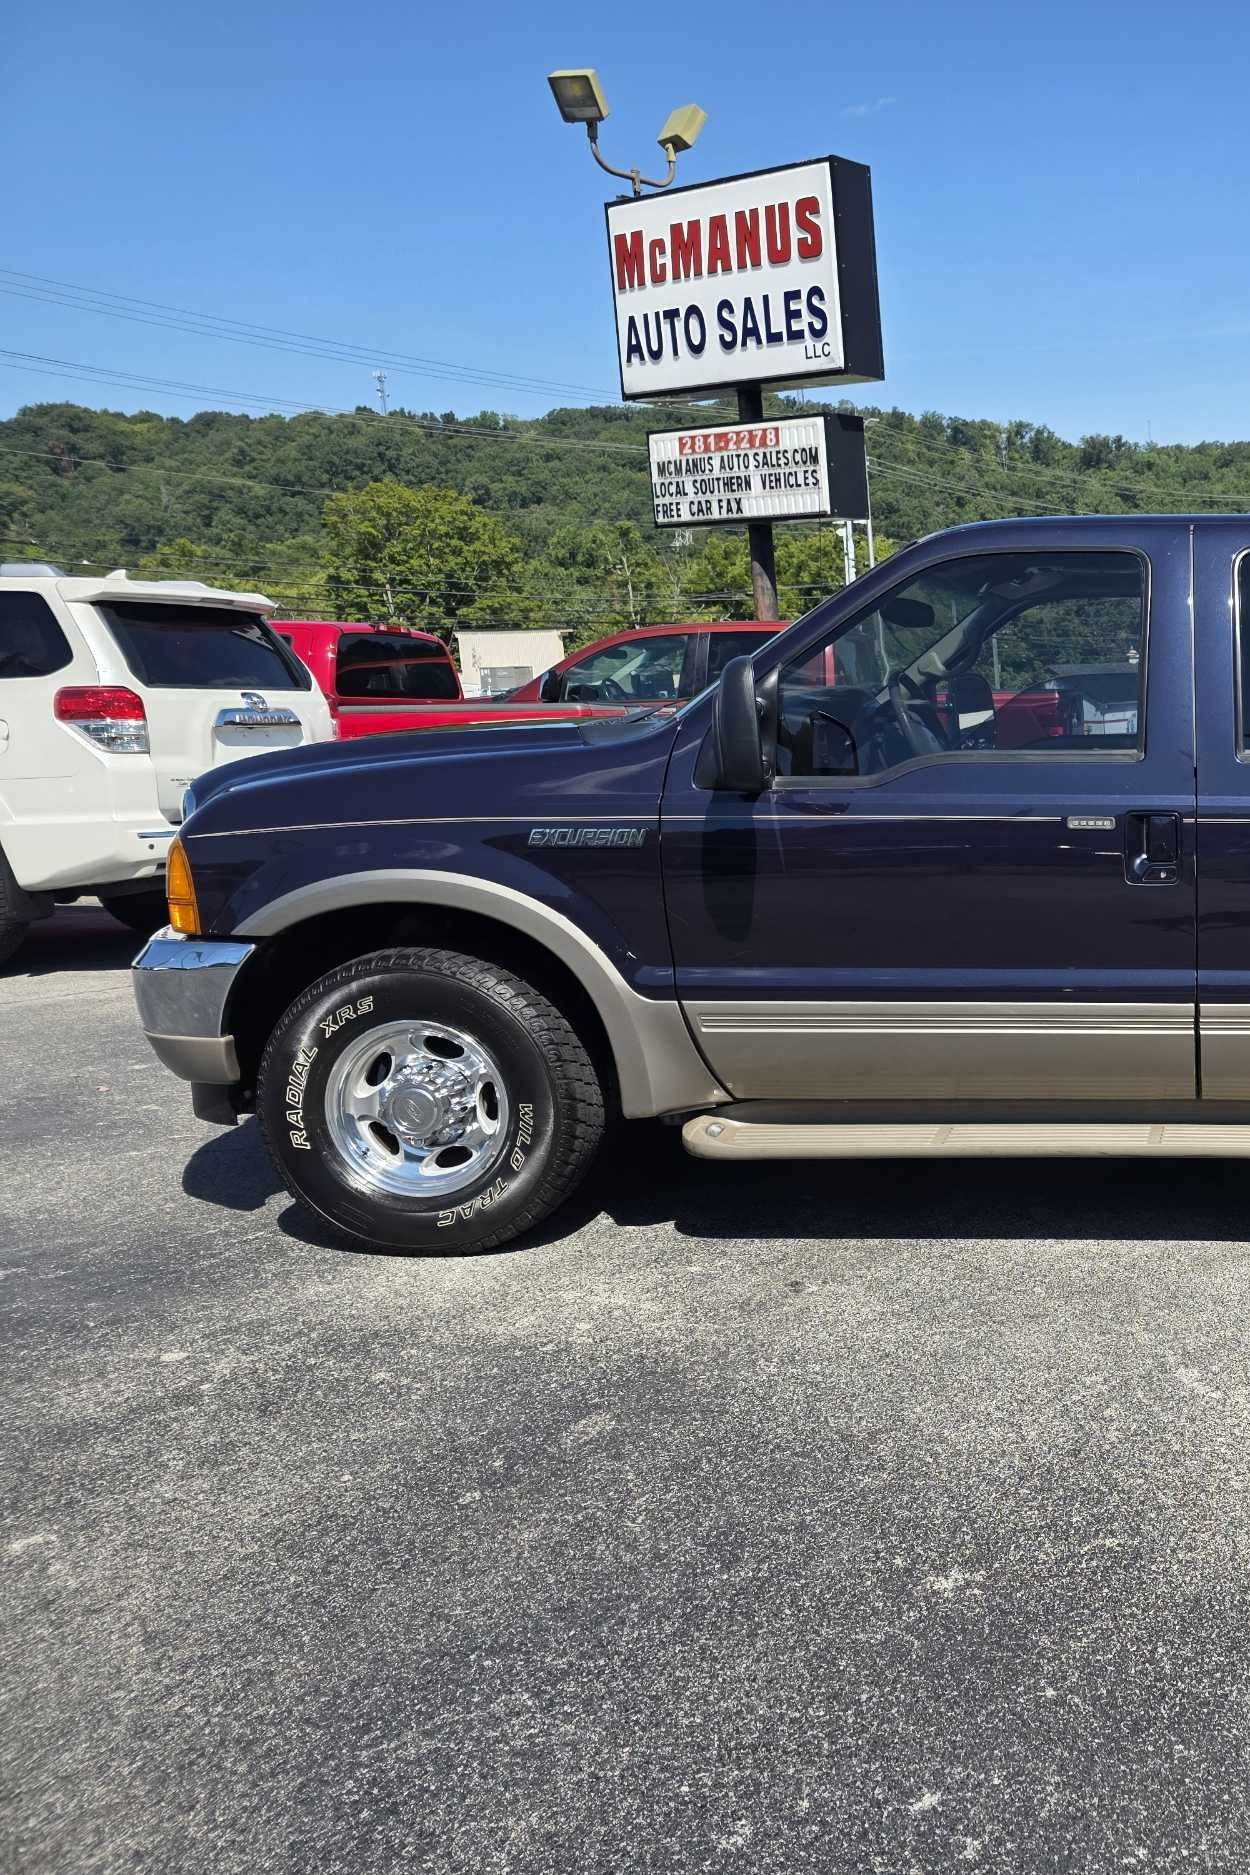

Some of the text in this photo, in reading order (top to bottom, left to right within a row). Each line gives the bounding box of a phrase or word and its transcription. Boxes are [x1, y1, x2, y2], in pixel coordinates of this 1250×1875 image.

[613, 195, 823, 290] McMANUS
[625, 285, 829, 364] AUTO SALES
[804, 342, 831, 360] LLC
[682, 428, 777, 454] 281-2278
[656, 456, 714, 478] MCMANUS
[719, 454, 750, 473] AUTO
[653, 469, 820, 499] LOCAL SOUTHERN VEHICLES
[655, 498, 744, 520] FREE CAR FAX
[528, 827, 649, 846] EXCURSION
[286, 996, 374, 1150] RADIAL XRS
[437, 1103, 533, 1227] WILD TRAC
